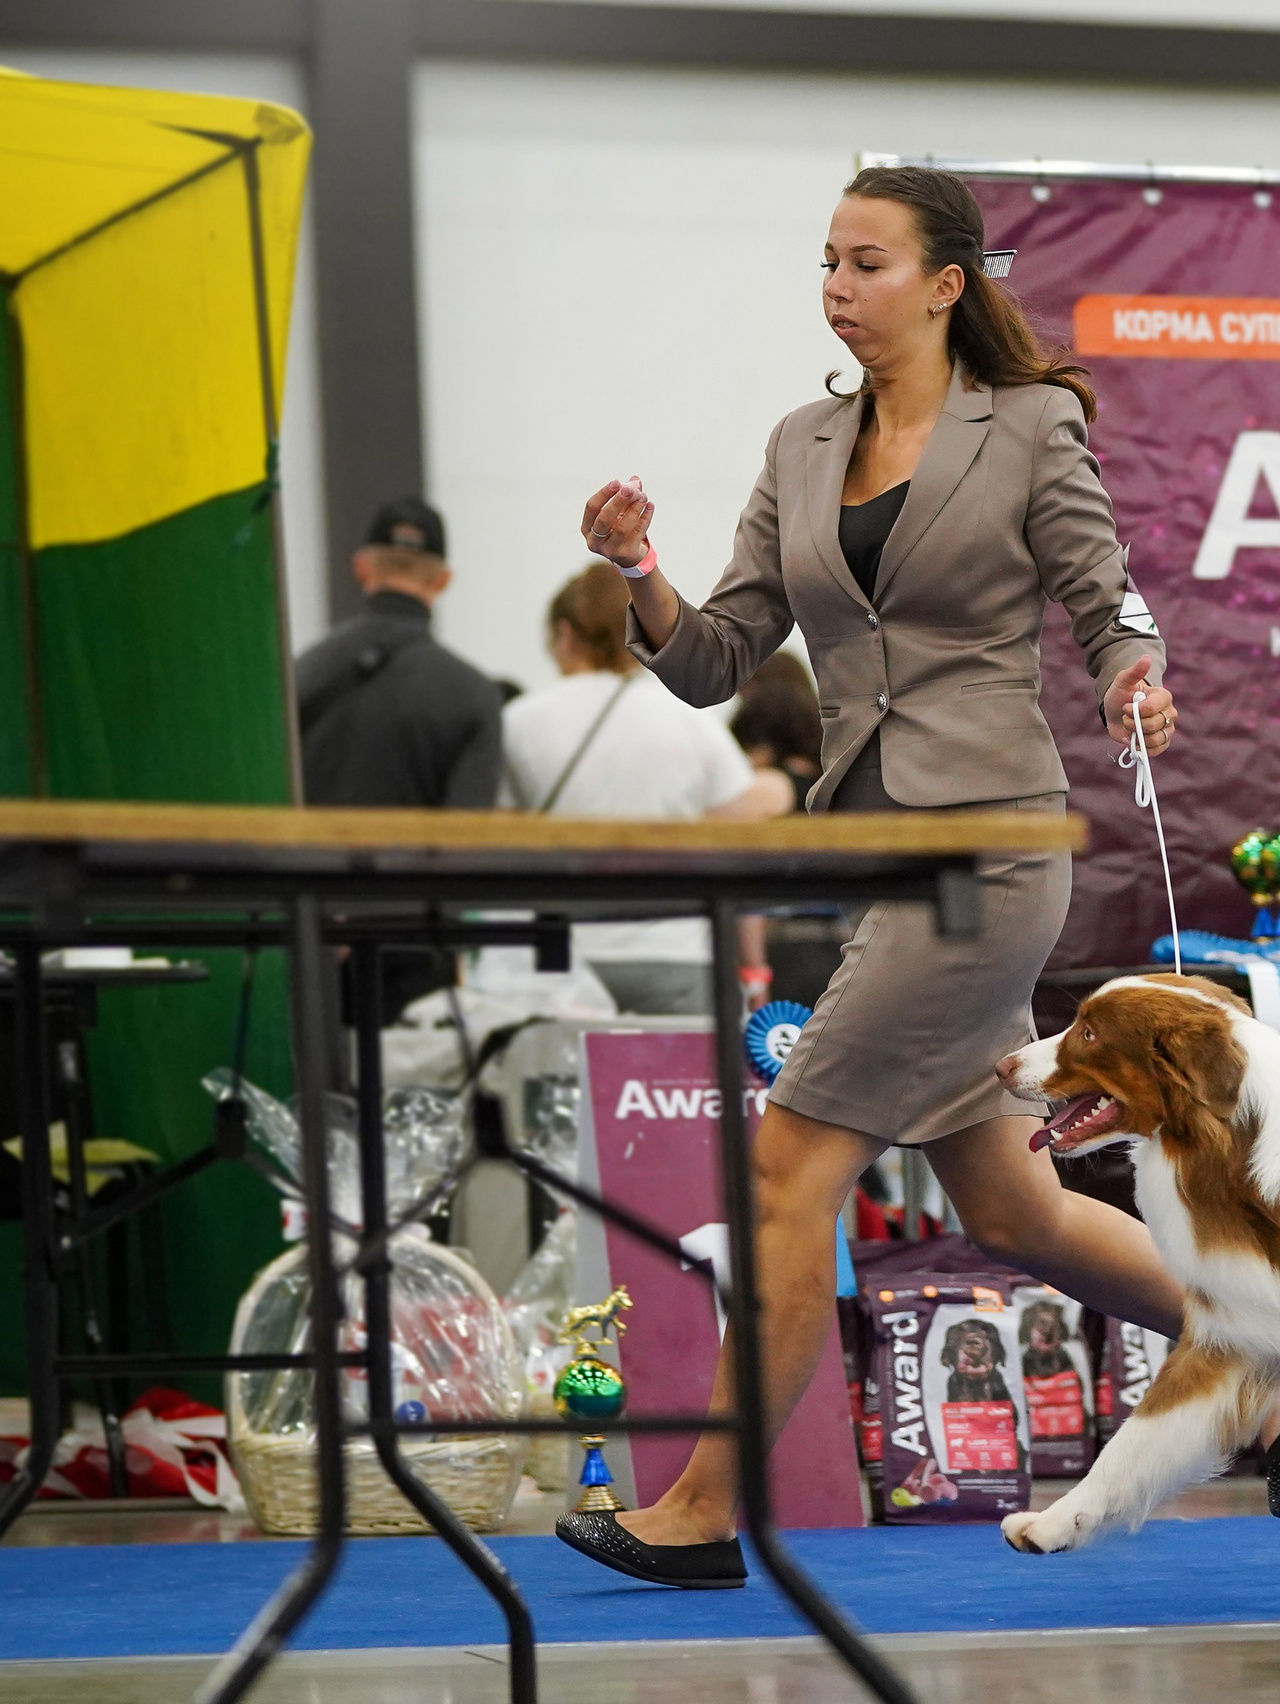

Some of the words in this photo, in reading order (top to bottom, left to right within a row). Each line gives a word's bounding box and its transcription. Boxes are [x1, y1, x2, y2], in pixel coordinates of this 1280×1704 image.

[1113, 309, 1214, 343] КОРМА
[879, 1310, 926, 1457] Award
[1119, 1320, 1151, 1408] Awa
